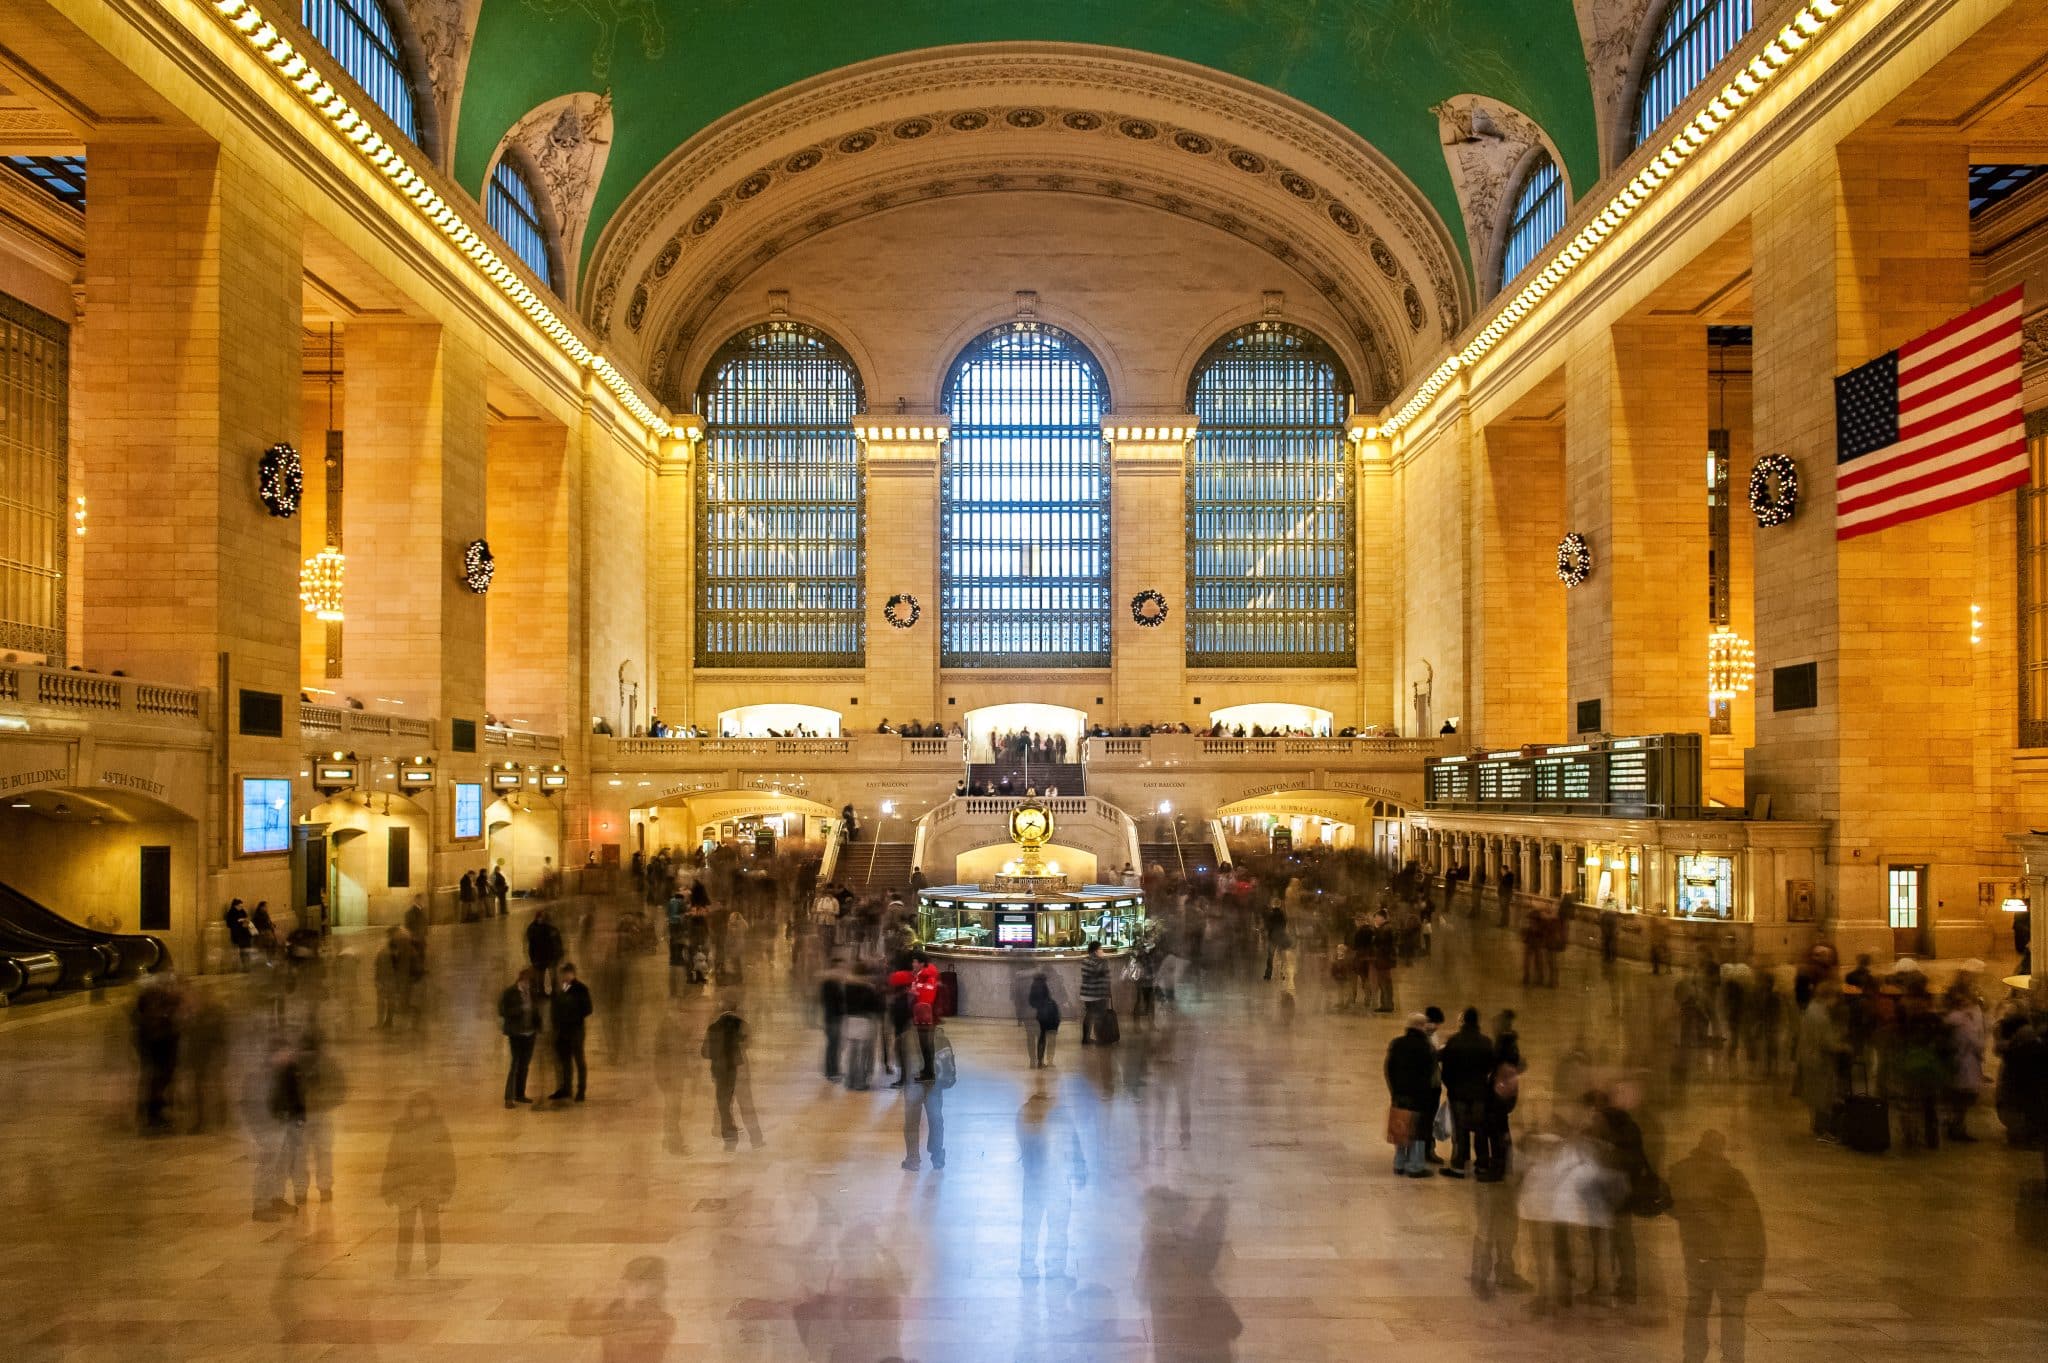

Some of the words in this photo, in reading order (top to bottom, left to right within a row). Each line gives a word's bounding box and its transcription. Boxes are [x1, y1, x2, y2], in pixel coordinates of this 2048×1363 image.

[11, 768, 66, 787] BUILDING
[102, 771, 128, 786] 45TH
[129, 775, 165, 795] STREET
[661, 784, 691, 796] TRACKS
[795, 789, 810, 797] AVE
[1242, 782, 1290, 797] LEXINGTON
[1290, 781, 1306, 789] AVE
[1334, 781, 1361, 790] TICKET
[1362, 784, 1402, 798] MACHINES
